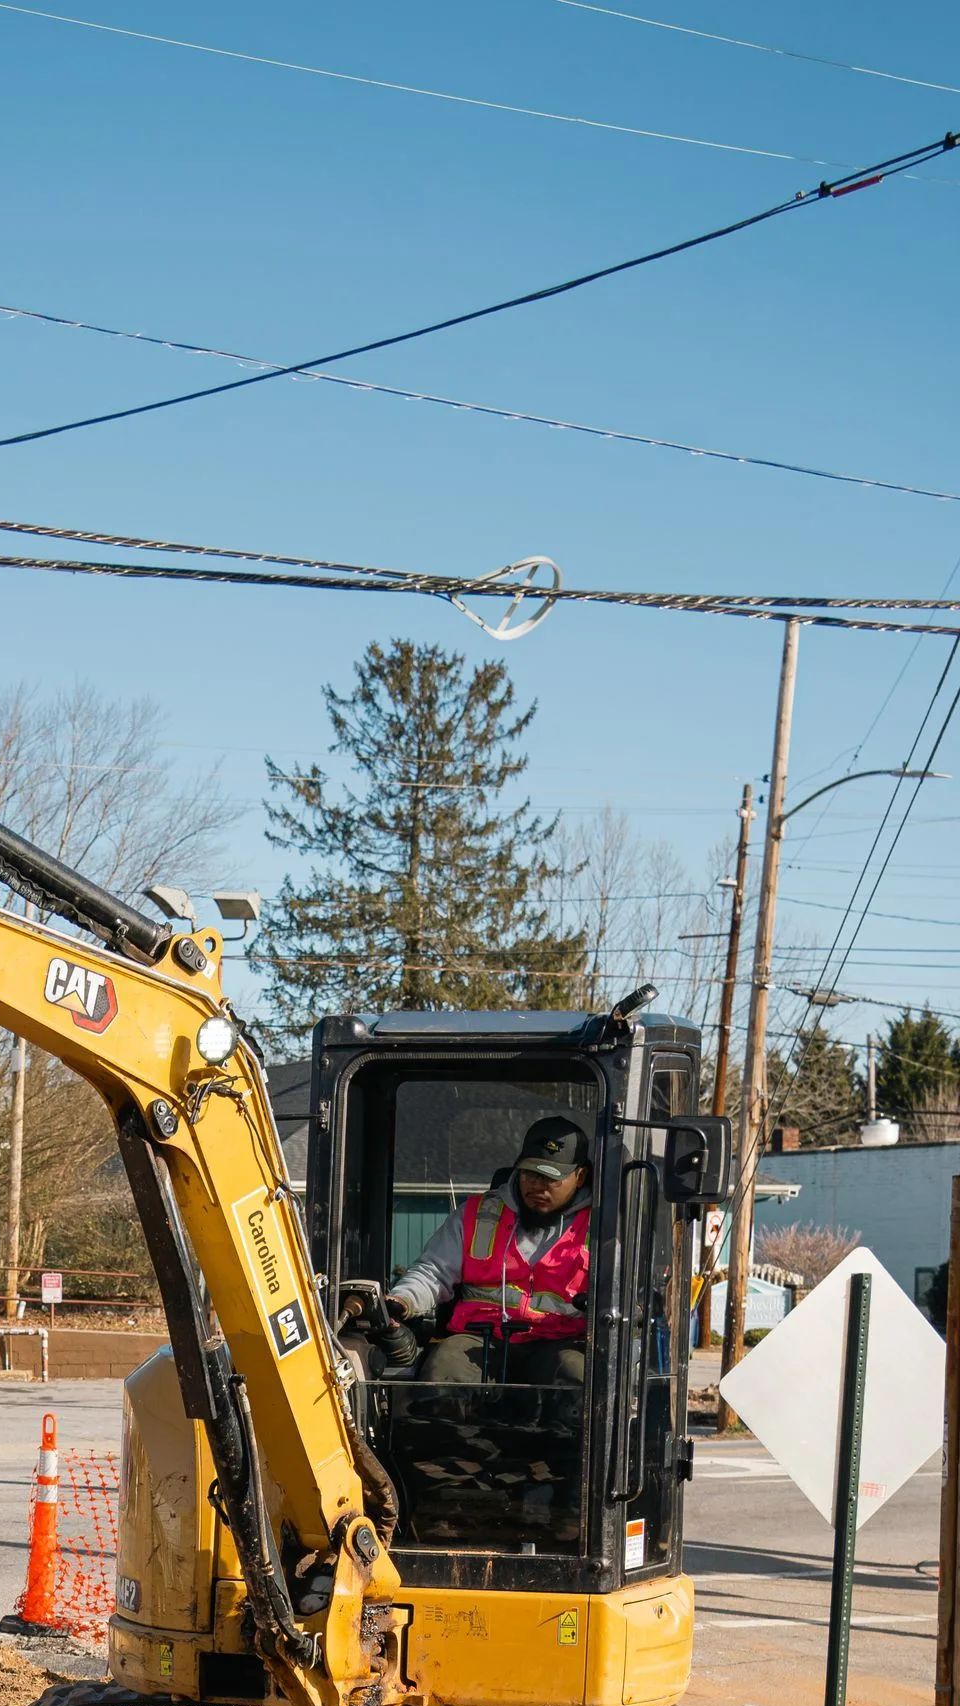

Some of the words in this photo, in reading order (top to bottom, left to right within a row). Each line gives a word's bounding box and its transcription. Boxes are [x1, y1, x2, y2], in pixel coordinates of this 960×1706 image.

[45, 958, 106, 1018] CAT
[248, 1209, 281, 1295] Carolina
[277, 1308, 301, 1346] CAT
